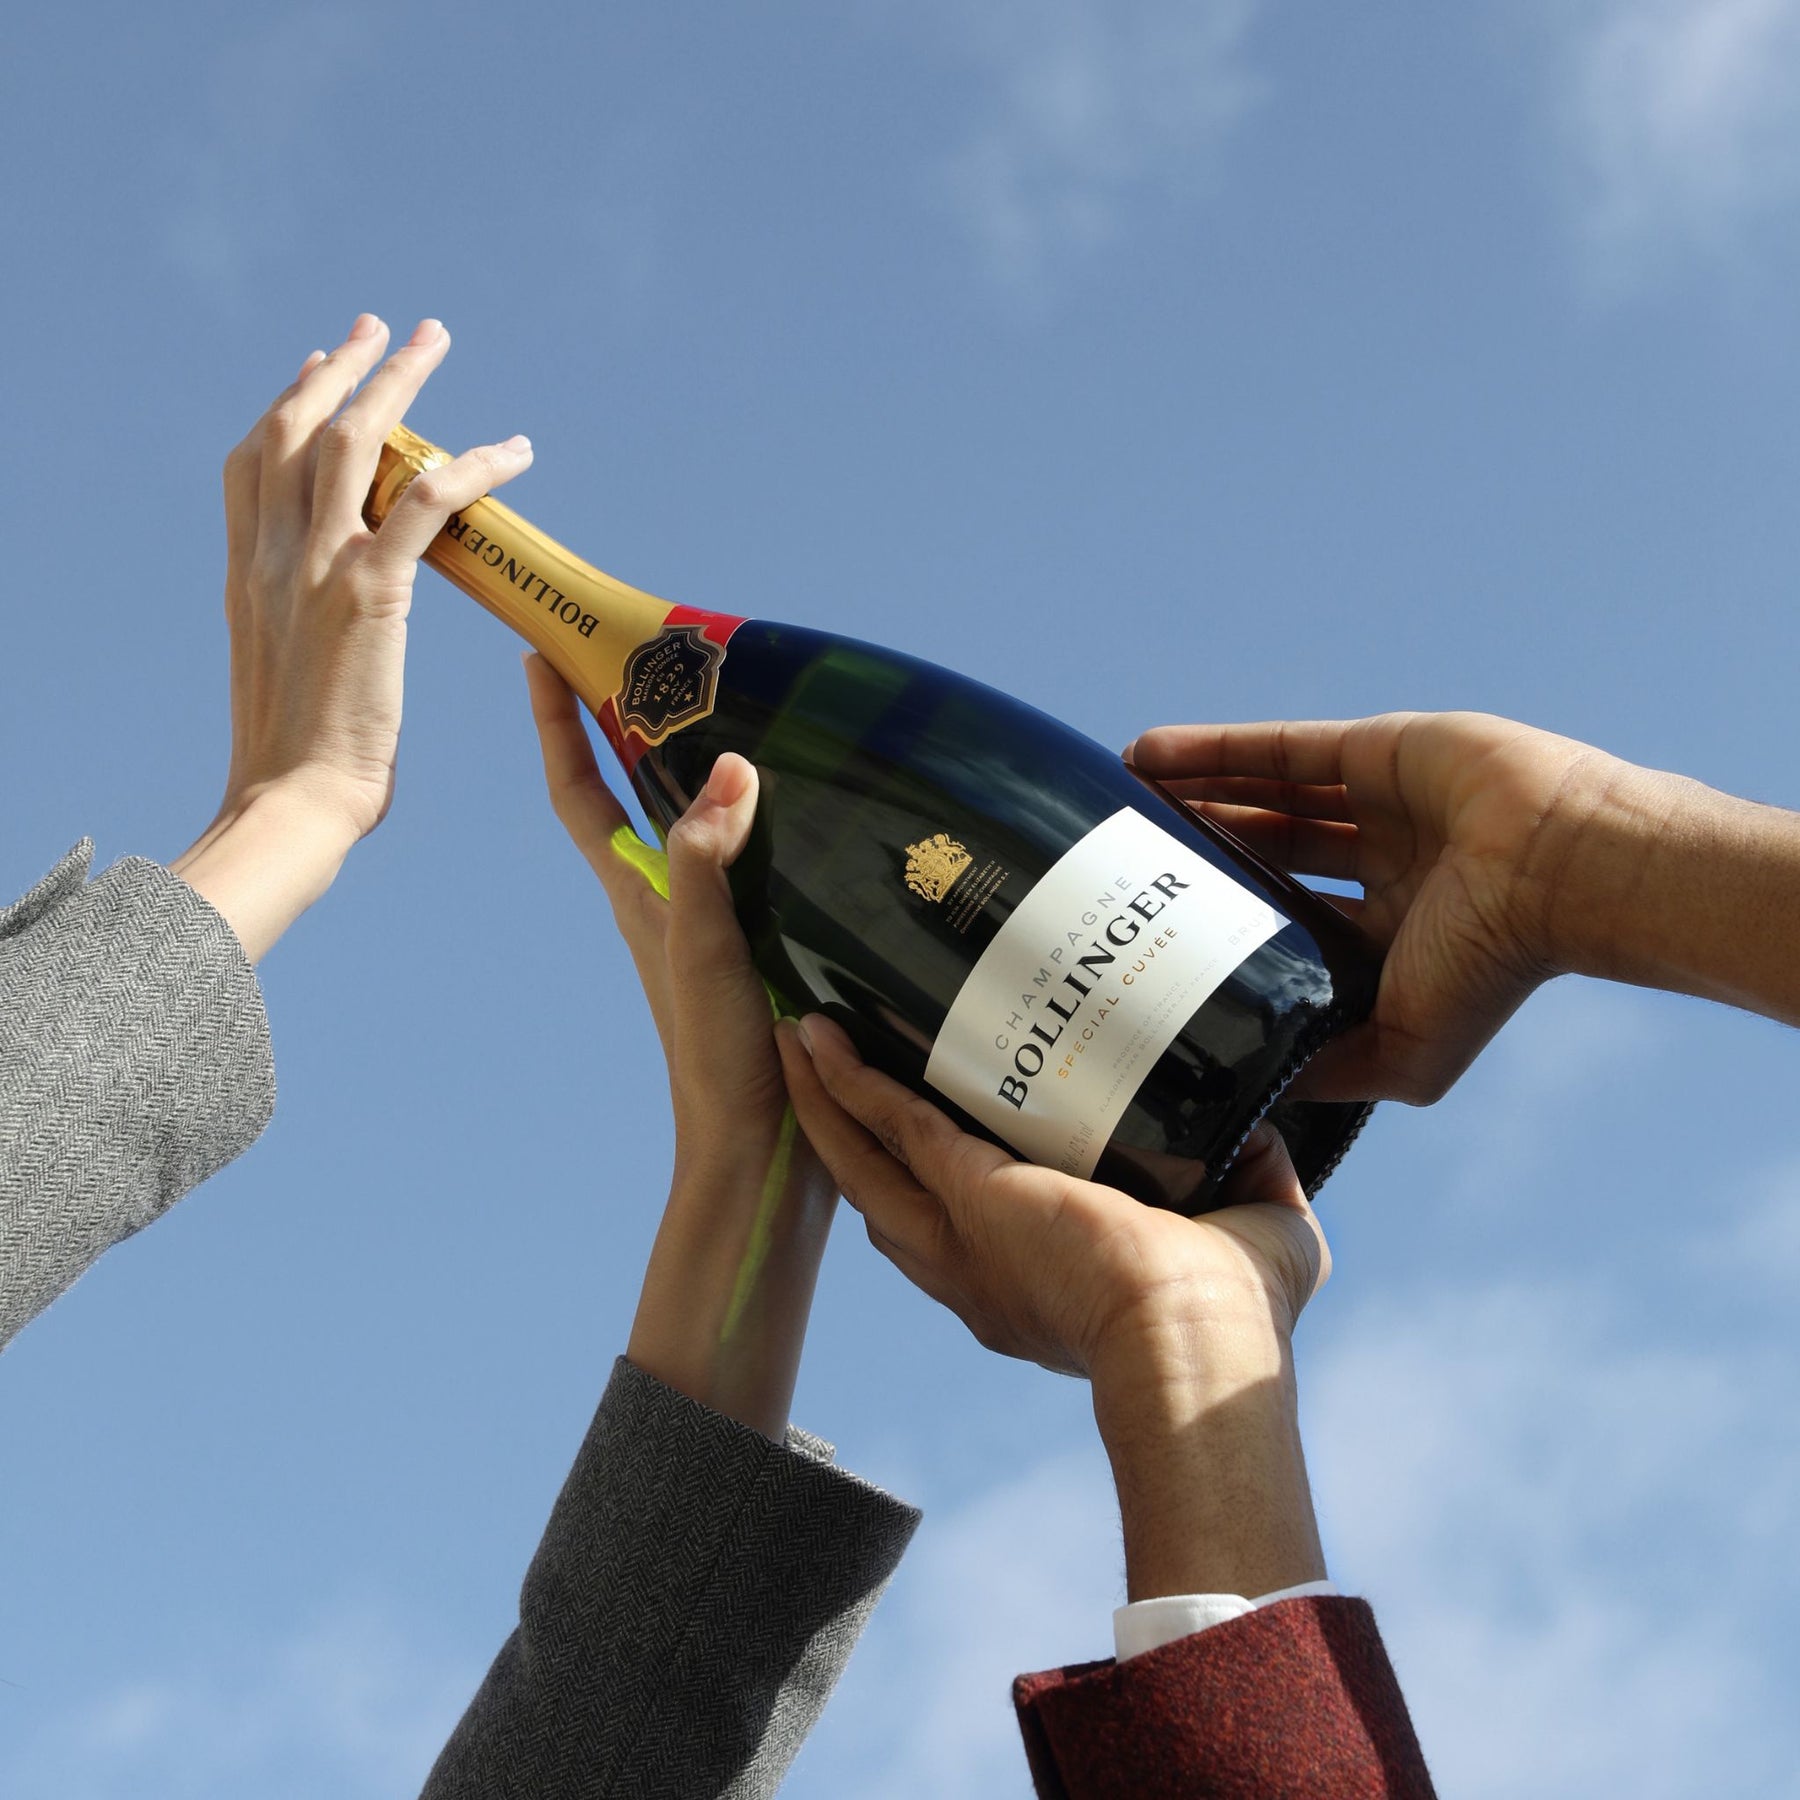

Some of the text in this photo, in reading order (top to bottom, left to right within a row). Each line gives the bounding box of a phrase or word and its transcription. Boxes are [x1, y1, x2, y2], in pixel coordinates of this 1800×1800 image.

[447, 515, 600, 638] BOLLINGER
[632, 642, 681, 705] BOLLINGER
[642, 674, 655, 701] MAISON
[653, 664, 684, 702] 1829
[671, 678, 692, 705] FRANCE
[953, 867, 978, 897] APPOINTMENT
[959, 888, 972, 904] QUEEN
[971, 864, 992, 888] ELIZABETH
[979, 865, 1002, 893] CHAMPAGNE
[960, 905, 982, 934] CHAMPAGNE
[980, 879, 1002, 905] BOLLINGER
[1228, 912, 1268, 945] BRUT
[995, 876, 1132, 1051] CHAMPAGNE
[997, 872, 1191, 1111] BOLLINGER
[1058, 927, 1178, 1079] SPECIAL CUVÉE
[1112, 1029, 1142, 1069] PRODUCE
